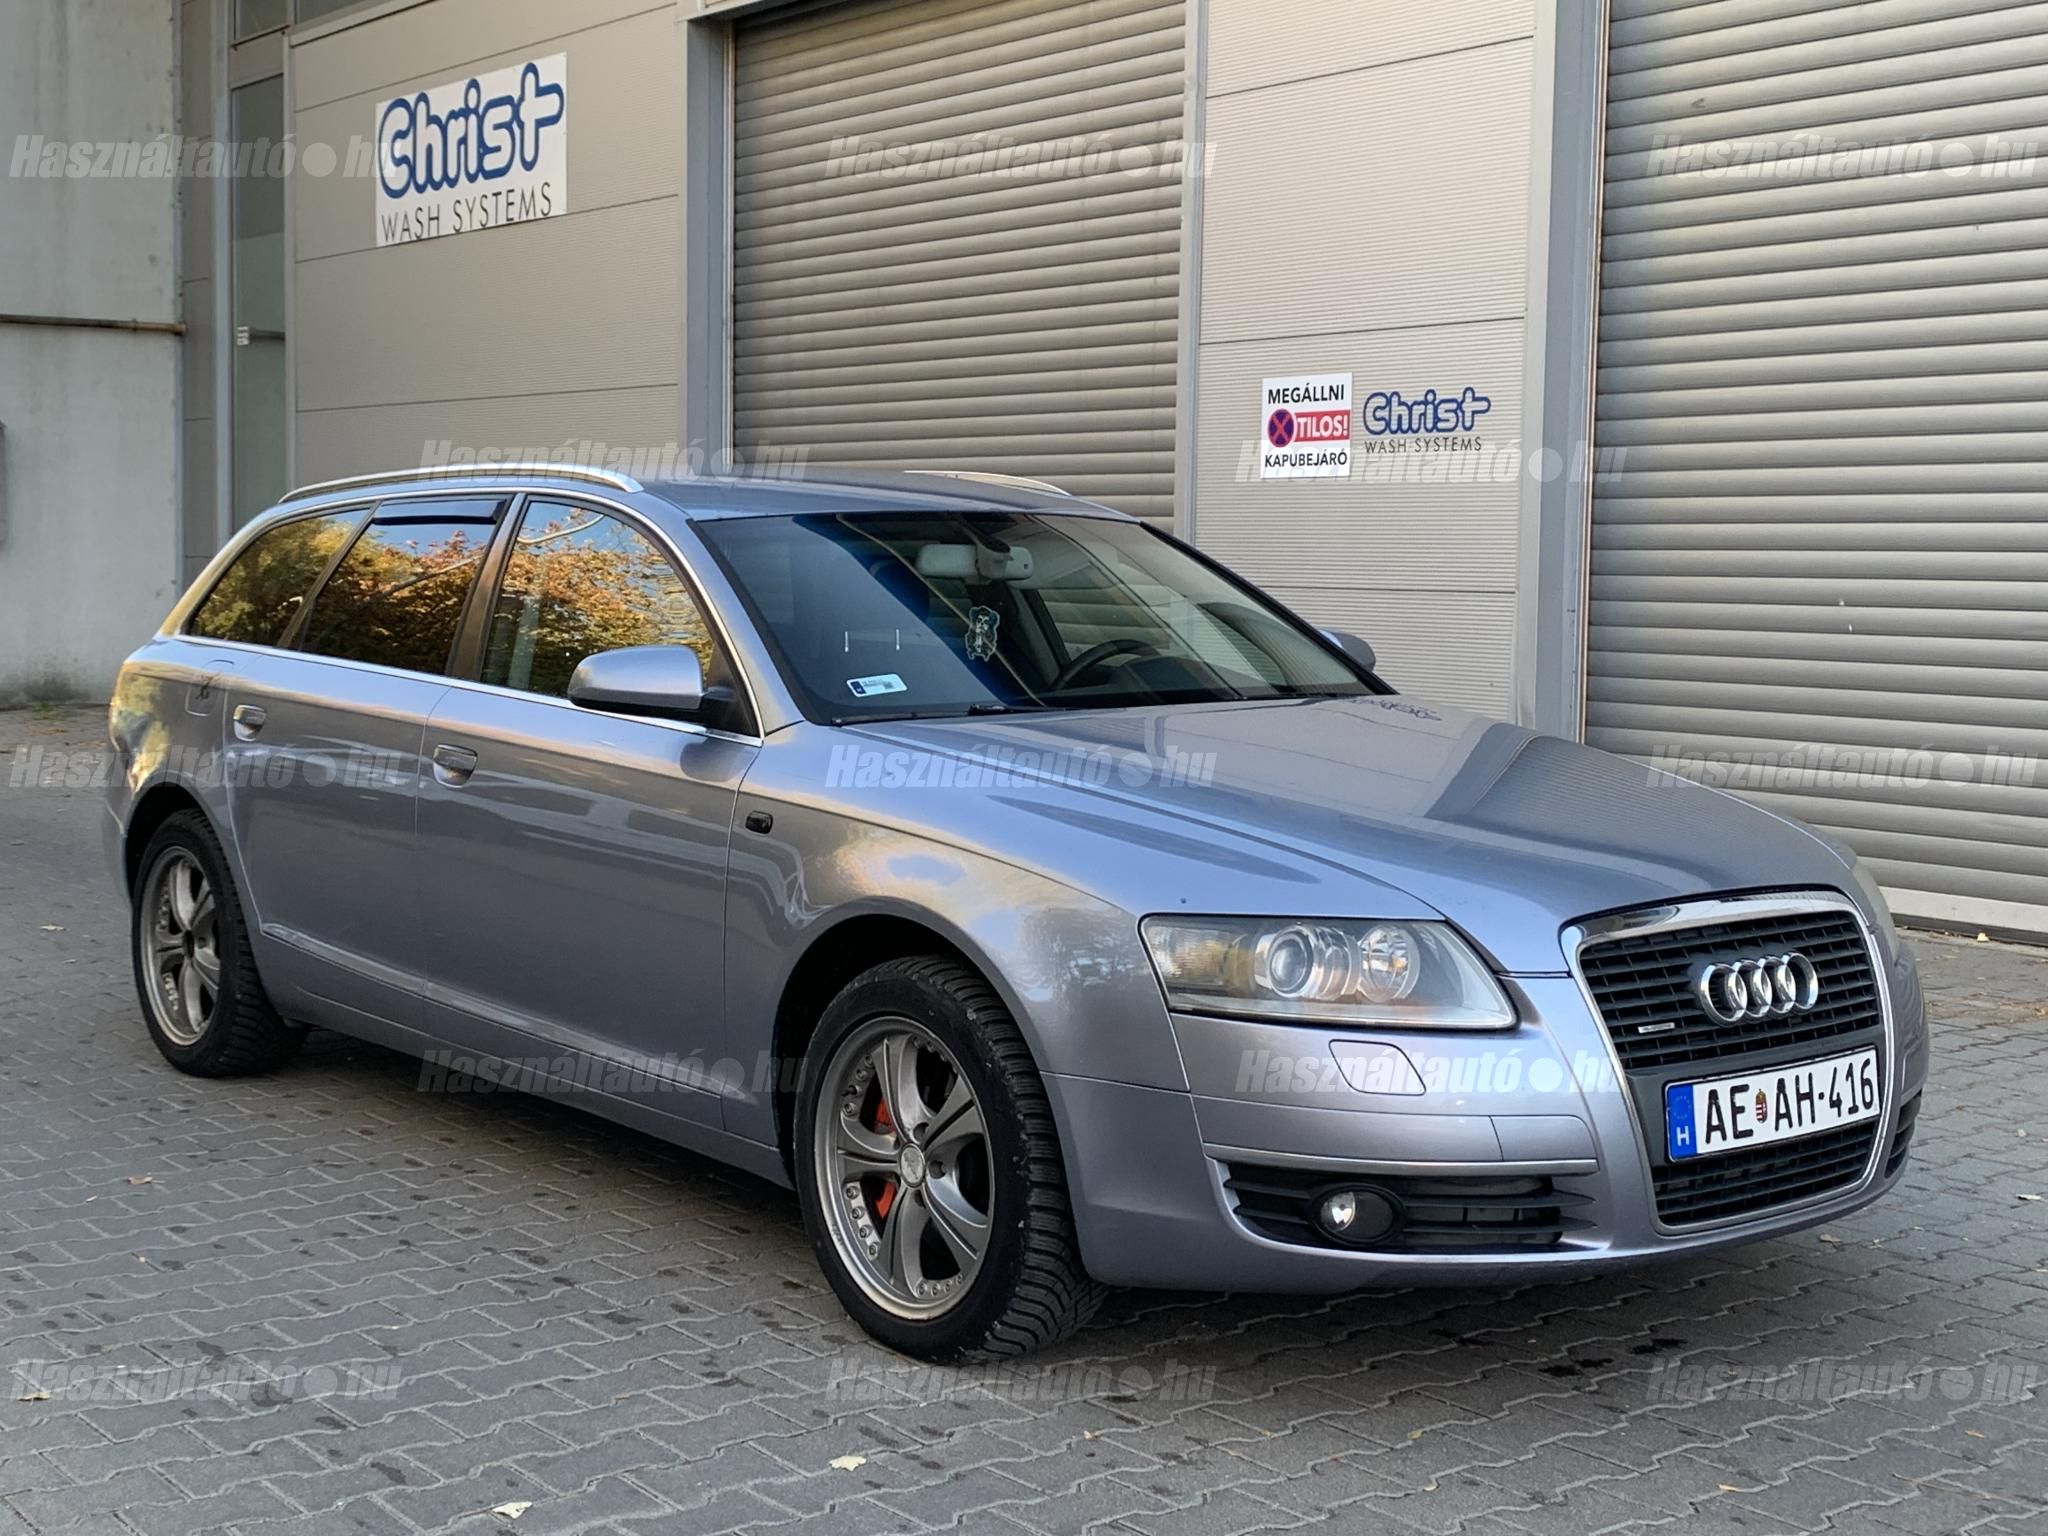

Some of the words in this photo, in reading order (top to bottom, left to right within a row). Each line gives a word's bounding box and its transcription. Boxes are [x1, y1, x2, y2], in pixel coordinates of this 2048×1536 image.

[379, 62, 565, 199] Christ
[381, 204, 441, 243] WASH
[453, 182, 552, 234] SYSTEMS
[1268, 382, 1345, 405] MEGÁLLNI
[1363, 386, 1492, 436] Christ
[1297, 414, 1349, 438] TILOS!
[1364, 438, 1407, 454] WASH
[1414, 435, 1483, 453] SYSTEMS
[1265, 448, 1348, 468] KAPUBEJÁRÓ
[1676, 1126, 1690, 1147] H
[1705, 1084, 1754, 1144] AE
